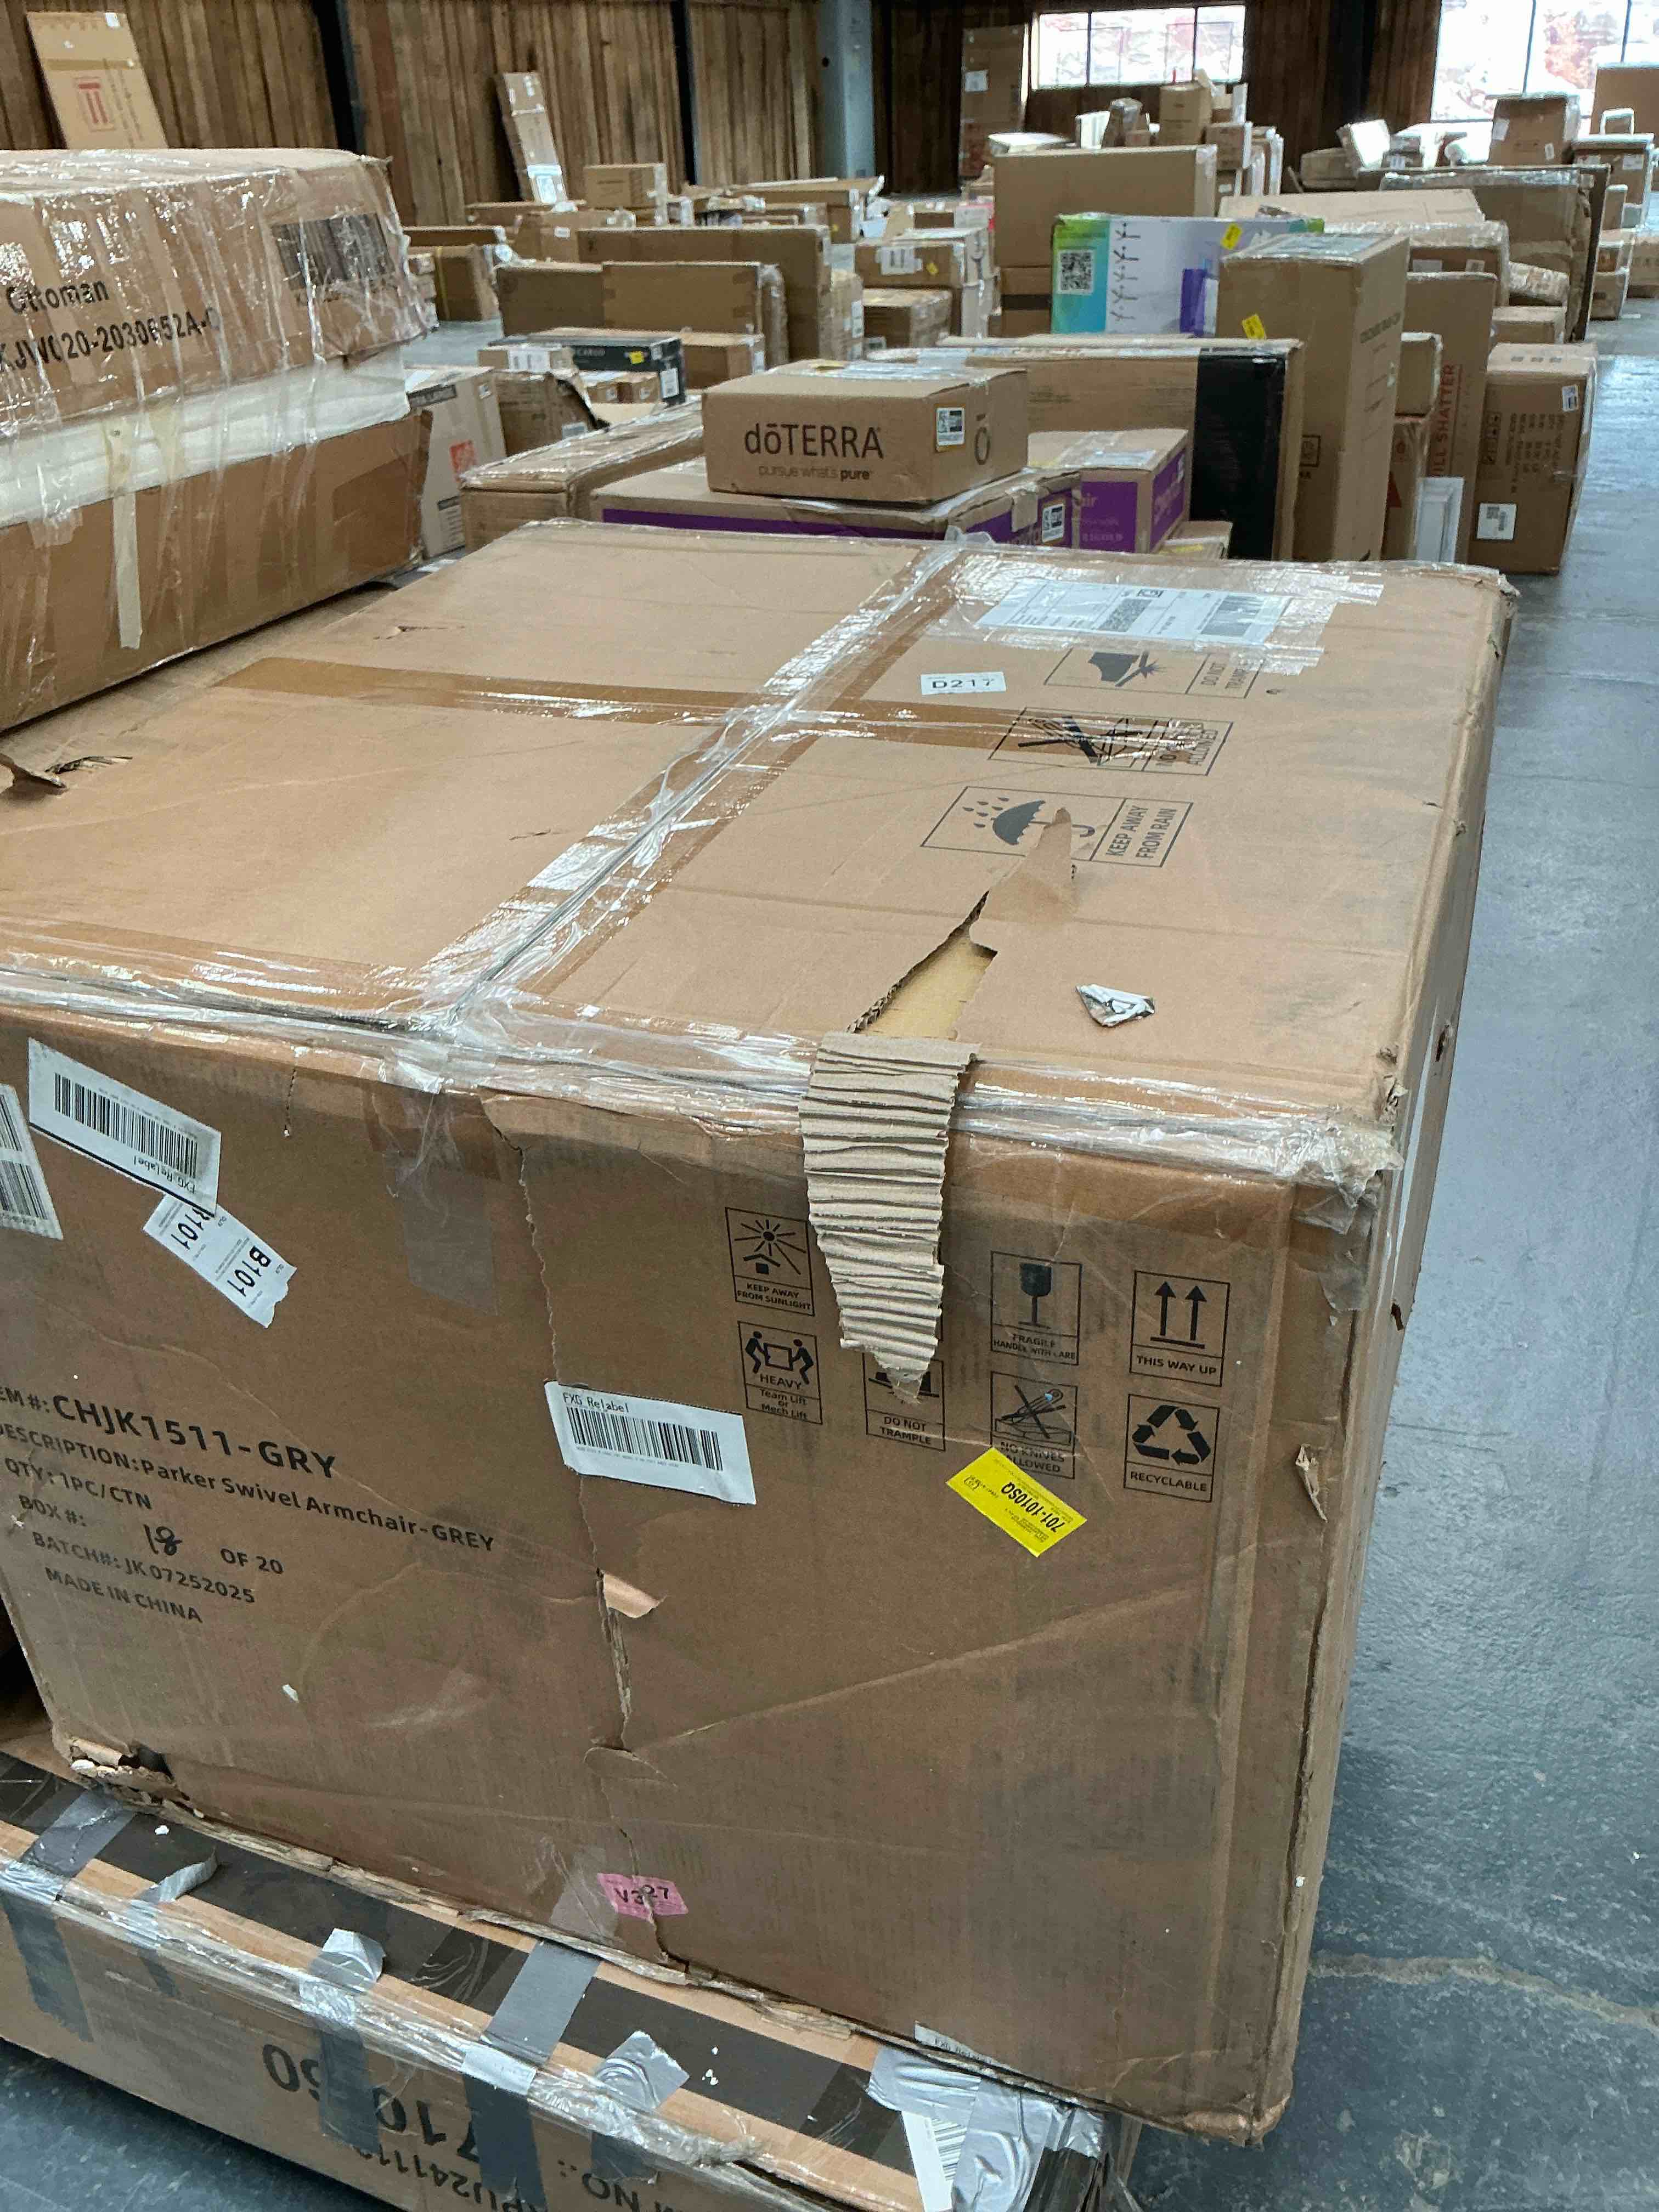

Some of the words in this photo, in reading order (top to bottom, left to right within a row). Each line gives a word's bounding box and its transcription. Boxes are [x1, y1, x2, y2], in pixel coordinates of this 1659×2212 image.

[840, 469, 871, 482] pure
[932, 678, 996, 690] D217
[1105, 832, 1133, 856] KEEP
[1120, 804, 1149, 832] AWAY
[1135, 831, 1165, 859] FROM
[1150, 808, 1178, 831] RAIN
[227, 1245, 273, 1297] B101
[737, 1290, 764, 1301] FROM
[765, 1295, 811, 1310] SUNLIGHT
[746, 1283, 770, 1293] KEEP
[772, 1288, 799, 1299] AWAY
[1136, 1355, 1164, 1367] THIS
[1167, 1359, 1195, 1372] WAY
[1199, 1364, 1216, 1375] UP
[759, 1373, 802, 1390] HEAVY
[562, 1391, 583, 1405] FXG
[759, 1388, 787, 1401] Team
[790, 1395, 808, 1406] Lift
[761, 1403, 788, 1415] Mech
[791, 1409, 808, 1421] Lift
[884, 1416, 900, 1426] DO
[903, 1419, 927, 1432] NOT
[879, 1426, 931, 1444] TRAMPLE
[1000, 1441, 1018, 1454] NO
[1130, 1471, 1207, 1492] RECYCLABLE
[223, 1476, 301, 1509] Swivel
[18, 1494, 62, 1521] BOX
[220, 1548, 249, 1567] OF
[256, 1556, 284, 1575] 20
[143, 1523, 183, 1556] 18
[44, 1566, 105, 1597] MADE
[106, 1585, 131, 1604] IN
[134, 1593, 203, 1624] CHINA
